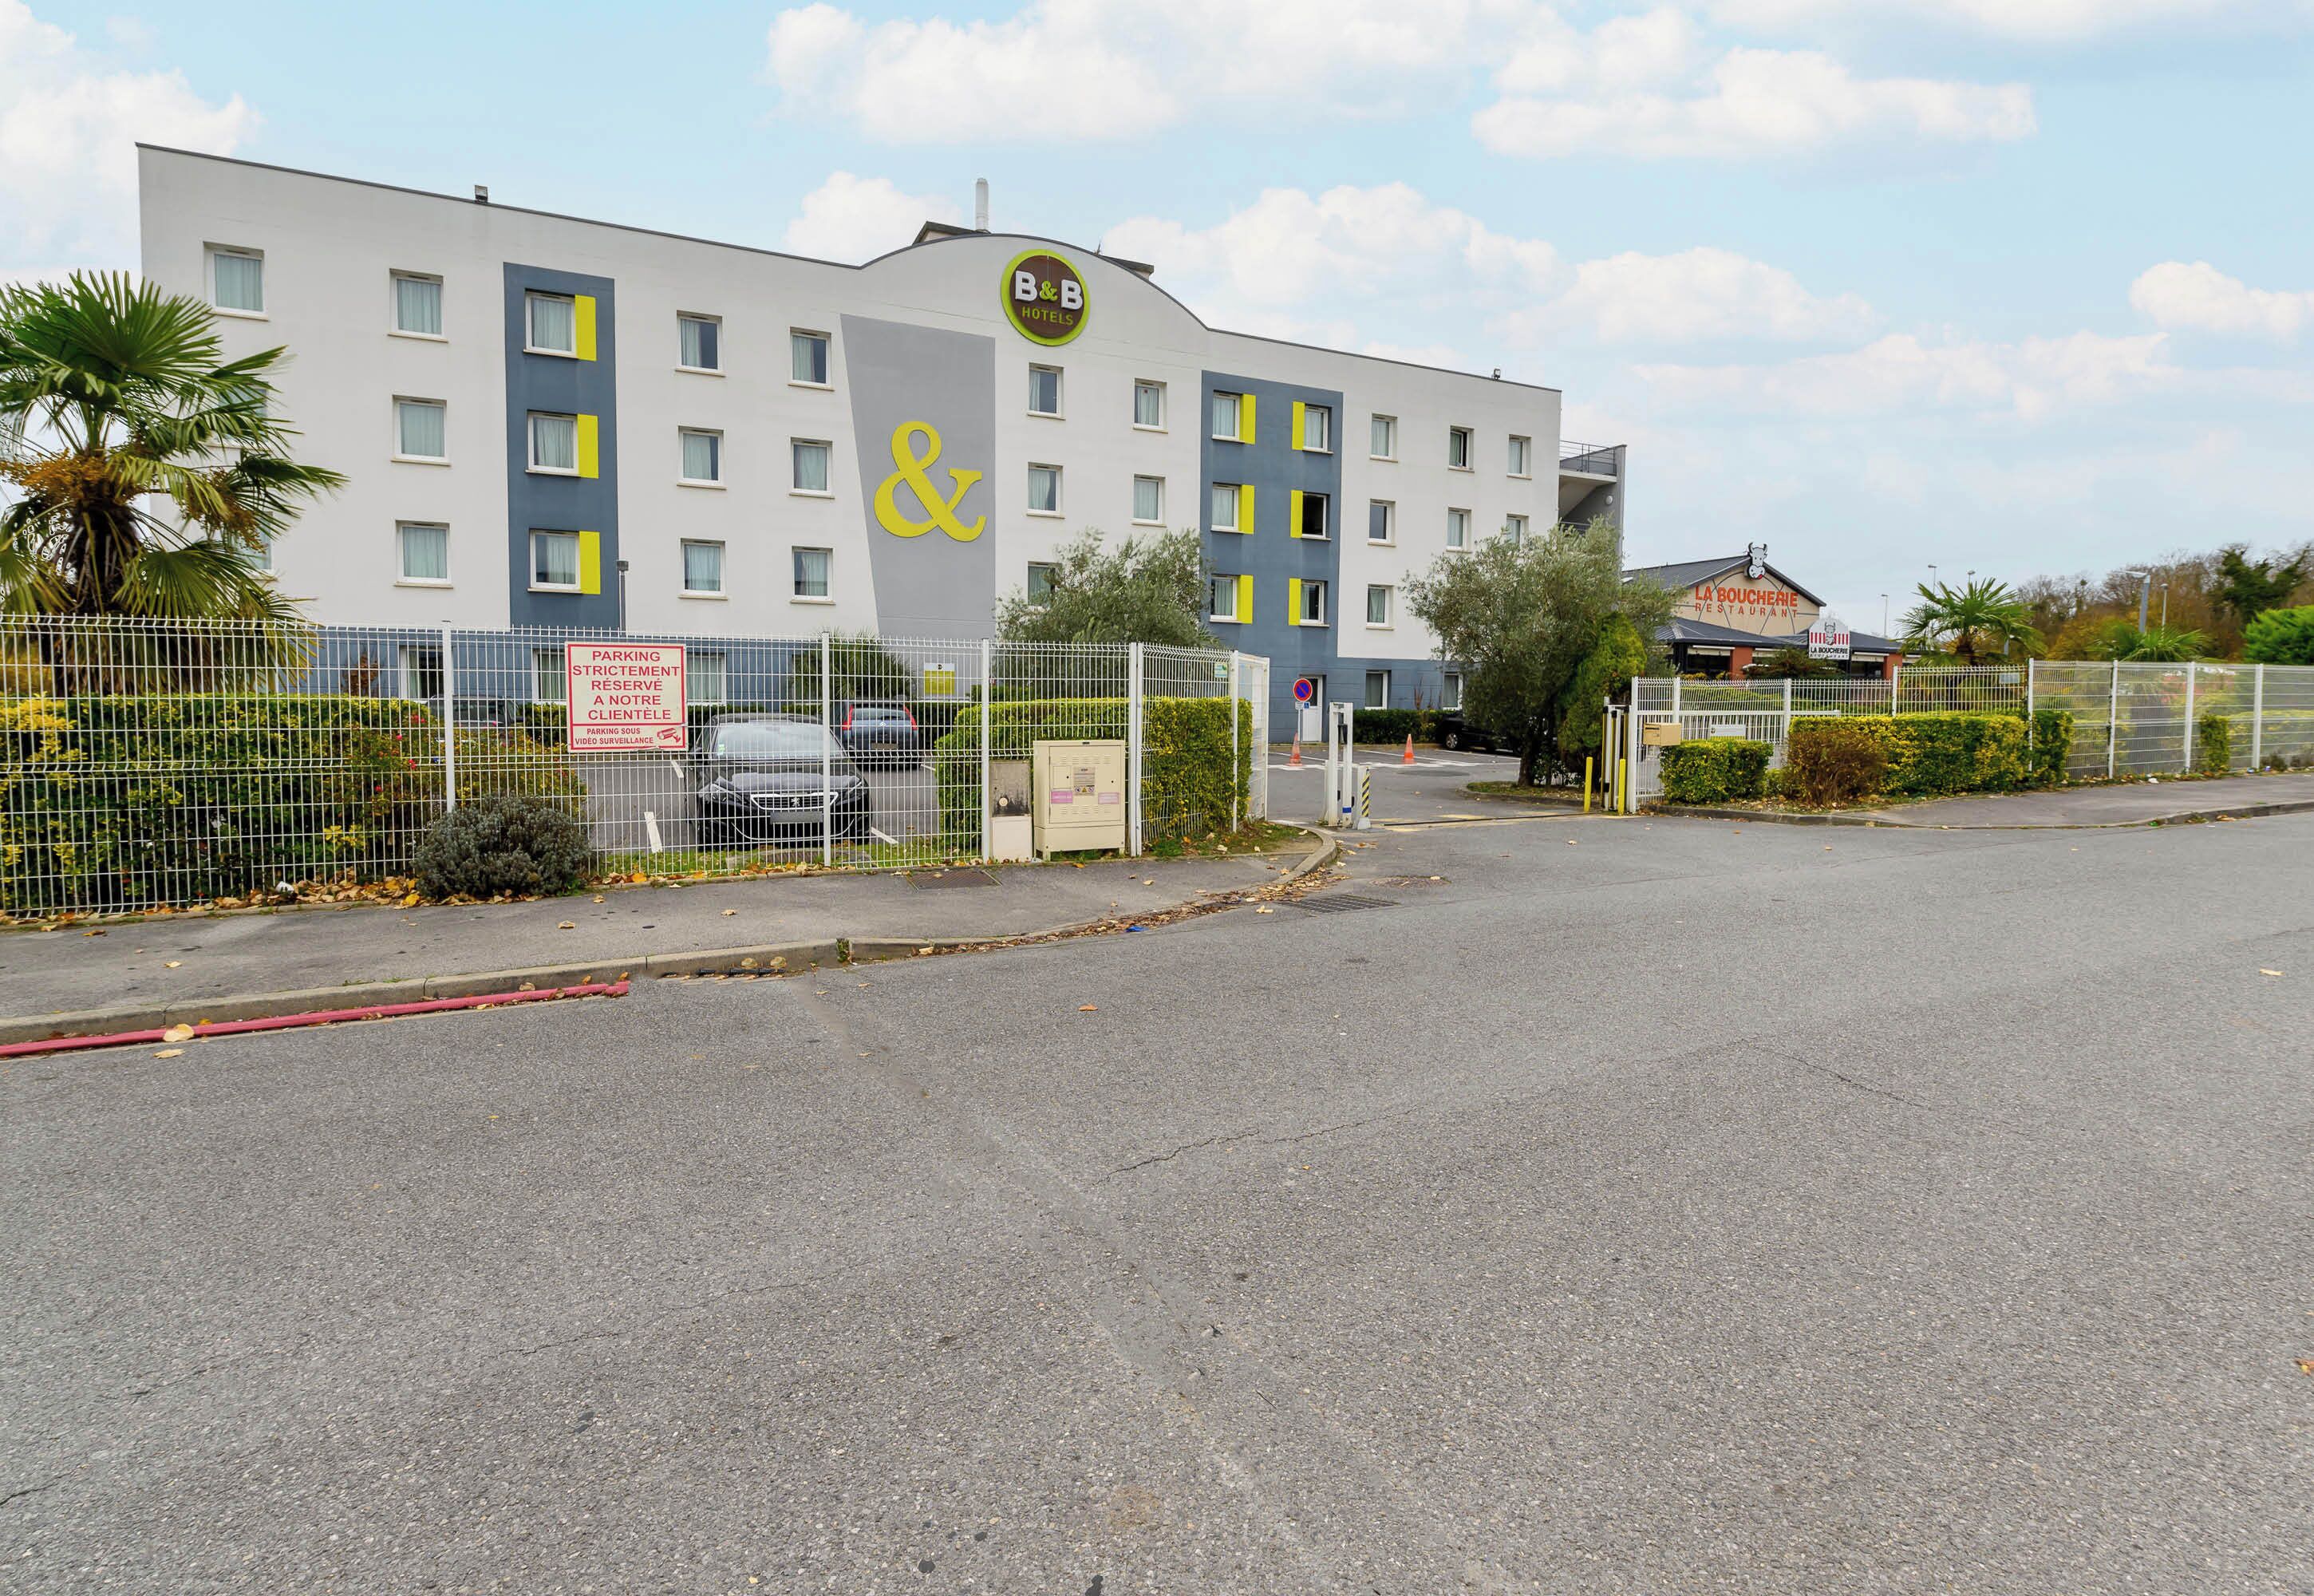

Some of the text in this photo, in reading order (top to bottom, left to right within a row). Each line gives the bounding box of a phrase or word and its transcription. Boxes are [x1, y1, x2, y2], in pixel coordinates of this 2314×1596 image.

[1015, 270, 1084, 310] B&B
[1022, 306, 1073, 326] HOTELS
[874, 421, 988, 543] &
[1695, 585, 1799, 606] LA BOUCHERIE
[1695, 602, 1798, 618] RESTAURANT
[592, 650, 661, 662] PARKING
[572, 665, 680, 676] STRICTEMENT
[591, 678, 663, 691] RÉSERVÉ
[593, 695, 661, 705] A NOTRE
[587, 707, 671, 721] CLIENTÈLE
